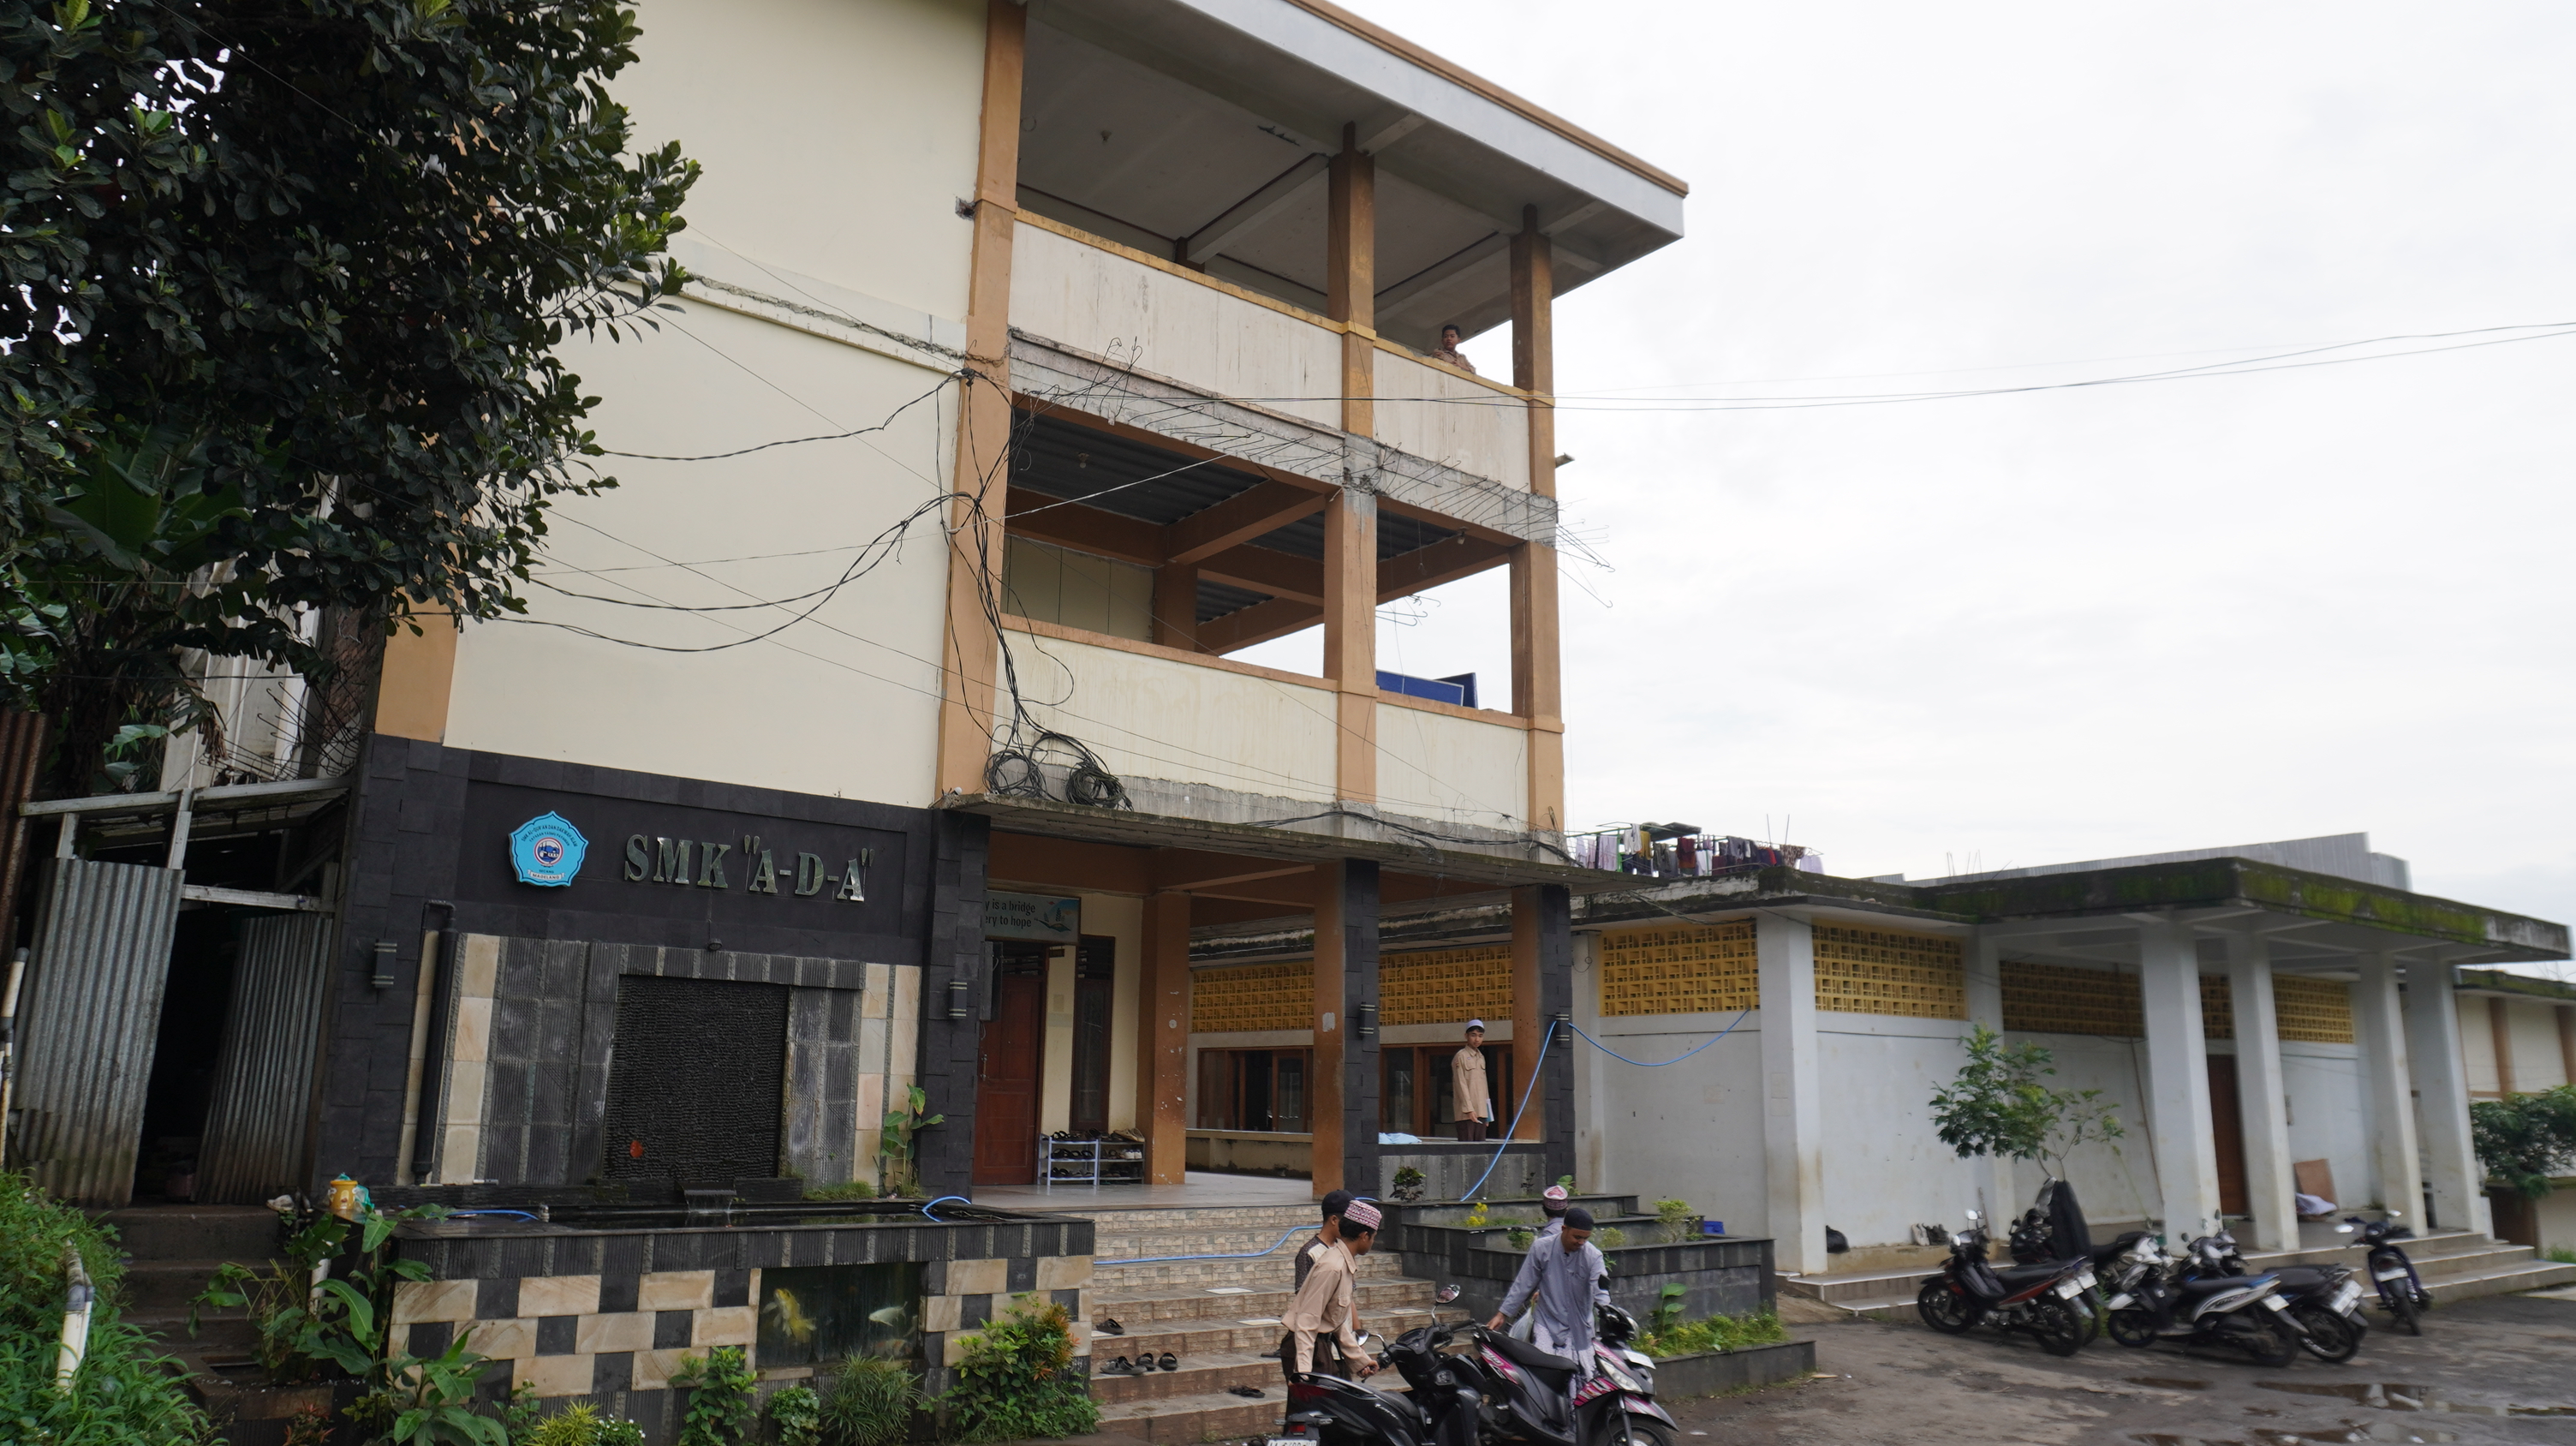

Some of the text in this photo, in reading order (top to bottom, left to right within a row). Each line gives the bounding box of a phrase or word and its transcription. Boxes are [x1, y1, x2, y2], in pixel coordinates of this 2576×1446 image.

[624, 834, 731, 889] SMK
[992, 898, 999, 910] is
[1001, 902, 1007, 911] a
[1009, 899, 1036, 916] bridge
[999, 915, 1009, 925] to
[1011, 915, 1032, 929] hope
